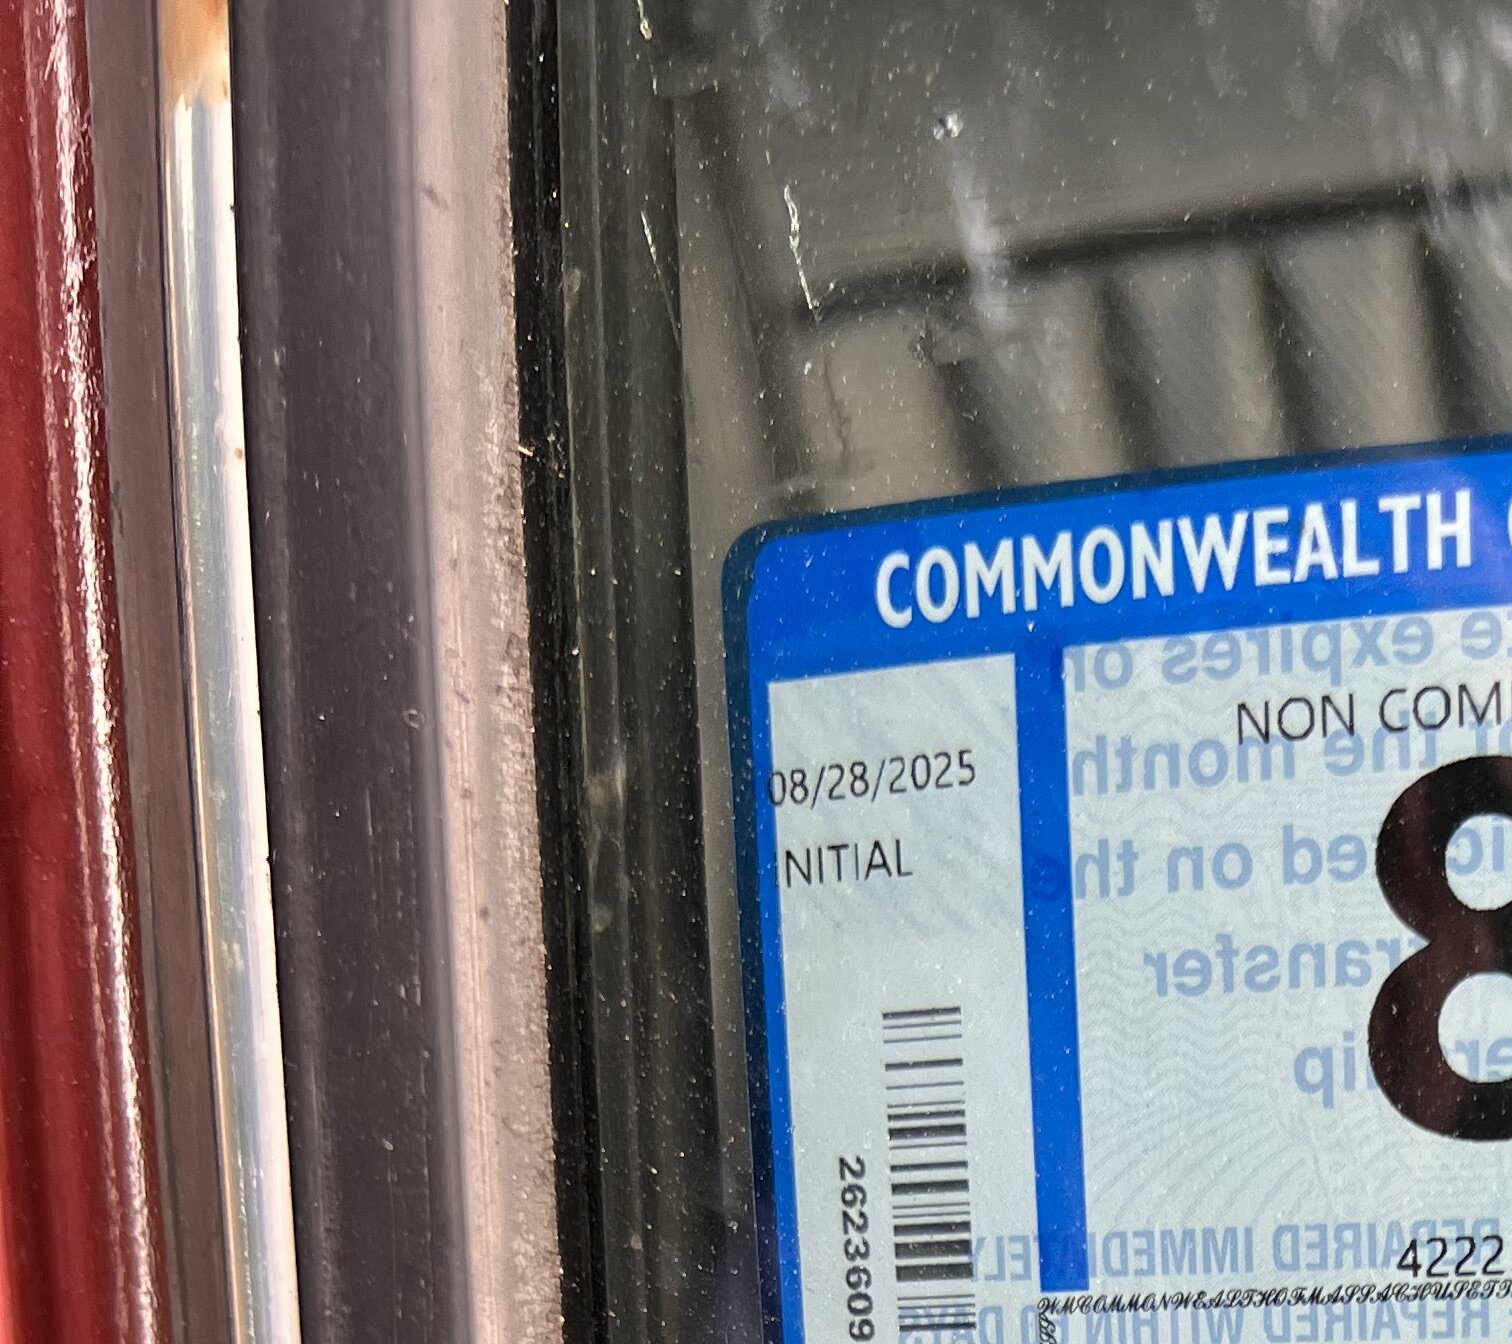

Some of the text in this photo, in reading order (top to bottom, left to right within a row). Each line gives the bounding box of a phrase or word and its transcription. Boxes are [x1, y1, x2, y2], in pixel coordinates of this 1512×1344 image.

[875, 488, 1472, 629] COMMONWEALTH
[1236, 692, 1357, 745] NON
[768, 749, 977, 809] 08/28/2025
